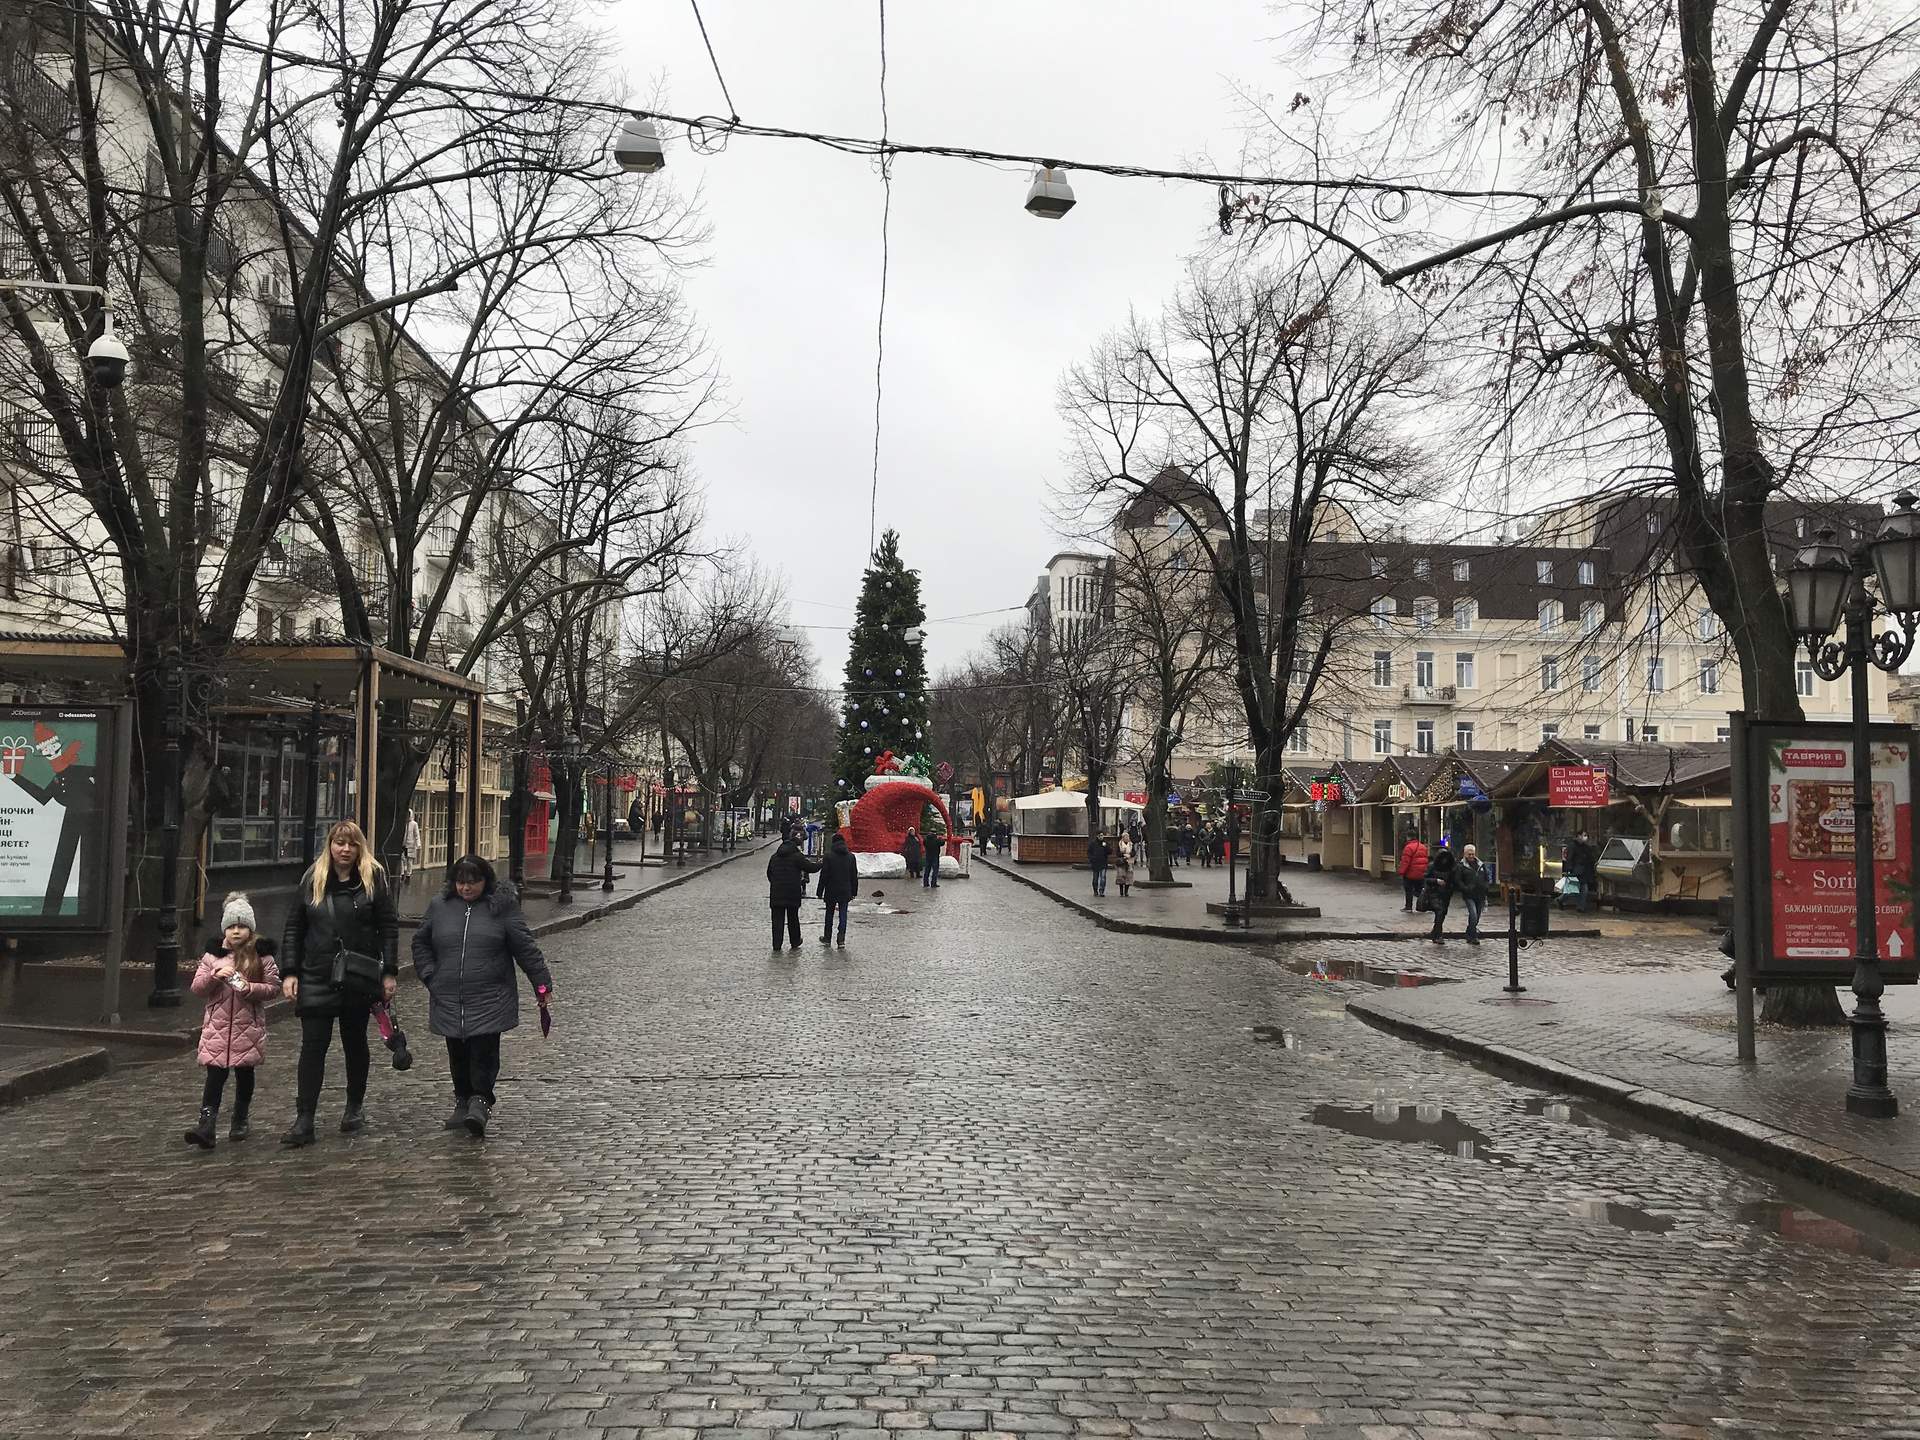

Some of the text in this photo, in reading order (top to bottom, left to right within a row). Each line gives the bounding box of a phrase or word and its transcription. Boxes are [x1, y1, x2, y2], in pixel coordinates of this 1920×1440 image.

[1785, 752, 1831, 761] ТАВРИЯ
[1784, 904, 1822, 913] БАЖАНИЙ
[1881, 905, 1904, 914] СВЯТА
